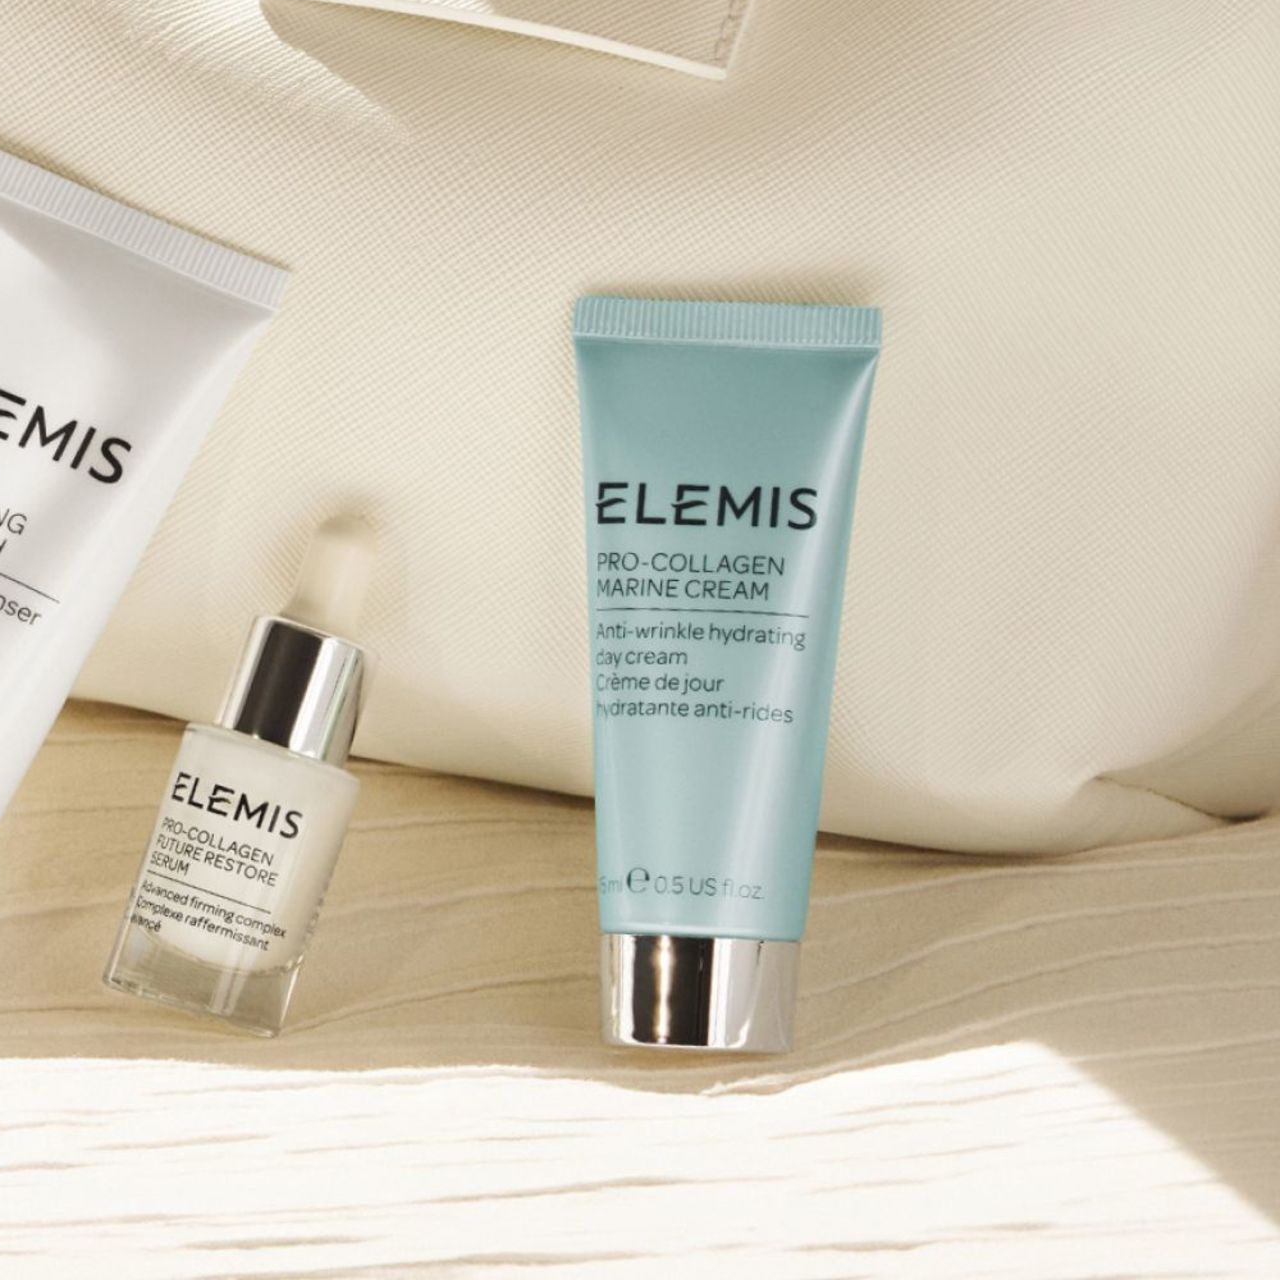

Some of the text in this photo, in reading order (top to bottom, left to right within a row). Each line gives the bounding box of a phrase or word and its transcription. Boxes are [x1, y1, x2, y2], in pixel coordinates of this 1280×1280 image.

[596, 482, 817, 531] ELEMIS
[597, 552, 785, 576] PRO-COLLAGEN
[596, 578, 769, 600] MARINE CREAM
[596, 622, 806, 652] Anti-wrinkle hydrating
[596, 649, 688, 669] day cream
[596, 674, 725, 696] Crème de jour
[694, 701, 794, 724] anti-rides
[171, 772, 303, 840] ELEMIS
[161, 816, 274, 866] PRO-COLLAGEN
[150, 851, 190, 876] SERUM
[156, 833, 279, 887] FUTURE RESTORE
[689, 877, 717, 897] US
[141, 879, 287, 939] Advanced firming complex
[135, 895, 270, 951] Complexe raffermissant
